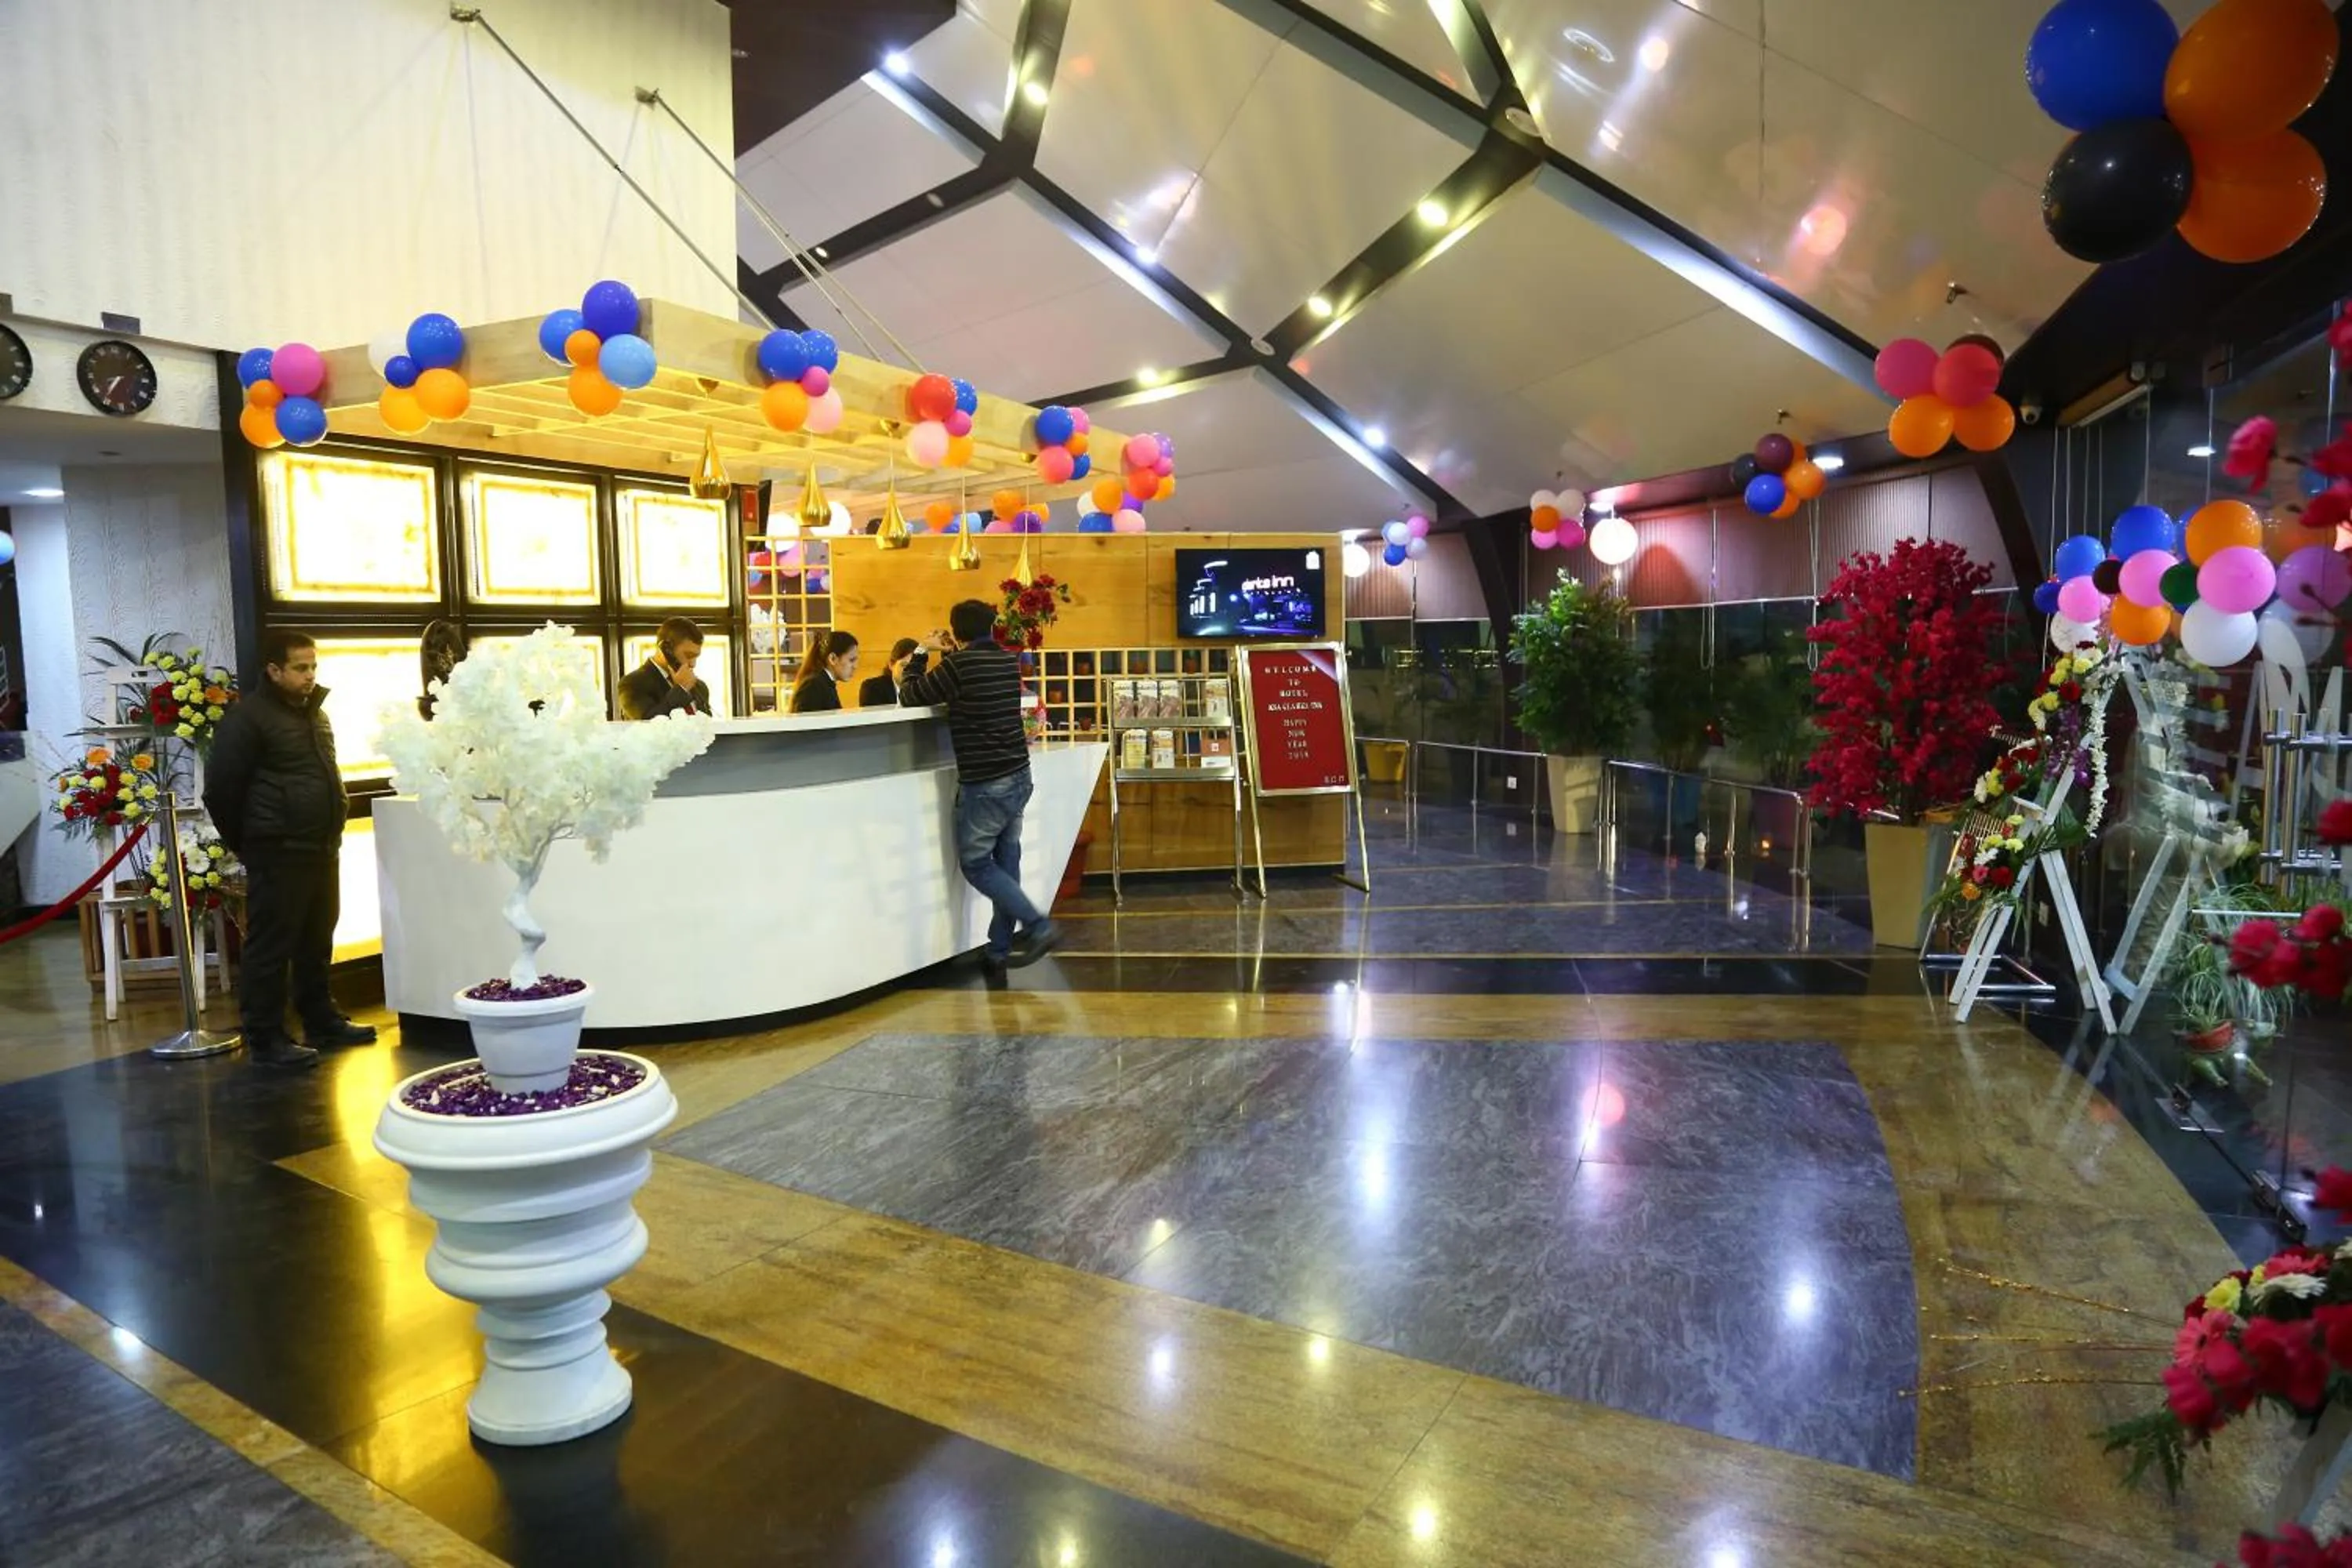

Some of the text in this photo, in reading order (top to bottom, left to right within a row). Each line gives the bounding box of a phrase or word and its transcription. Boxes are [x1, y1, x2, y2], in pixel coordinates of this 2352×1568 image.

[1265, 665, 1316, 674] WELCOME
[1287, 678, 1301, 687] TO
[1279, 689, 1308, 698] HOTEL
[1283, 718, 1307, 727] HAPPY
[1287, 739, 1308, 749] YEAR
